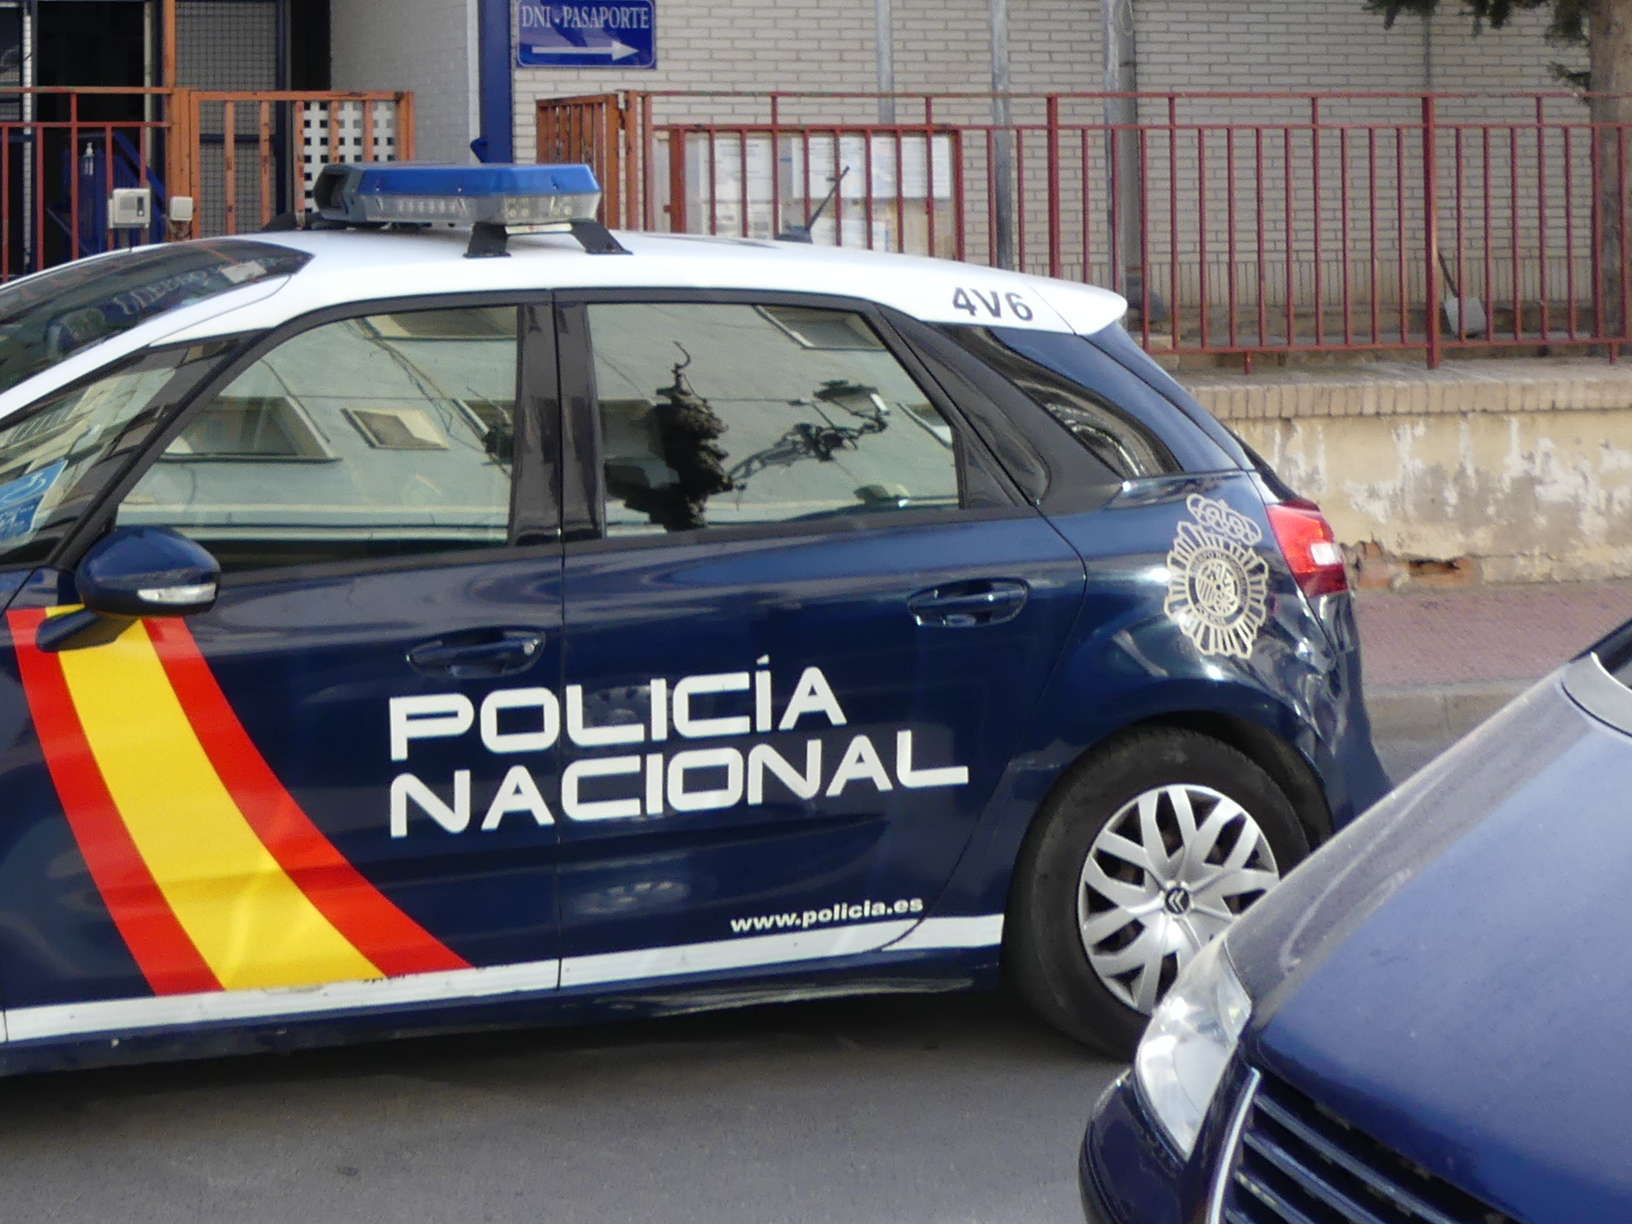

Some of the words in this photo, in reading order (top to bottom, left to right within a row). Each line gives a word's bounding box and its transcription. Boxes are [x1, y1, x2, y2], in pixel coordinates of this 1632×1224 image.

[521, 6, 552, 28] DNI
[563, 6, 650, 29] PASAPORTE
[952, 287, 1033, 321] 4V6
[388, 654, 847, 761] POLICÍA
[389, 730, 969, 839] NACIONAL
[730, 898, 924, 932] www.policia.es
